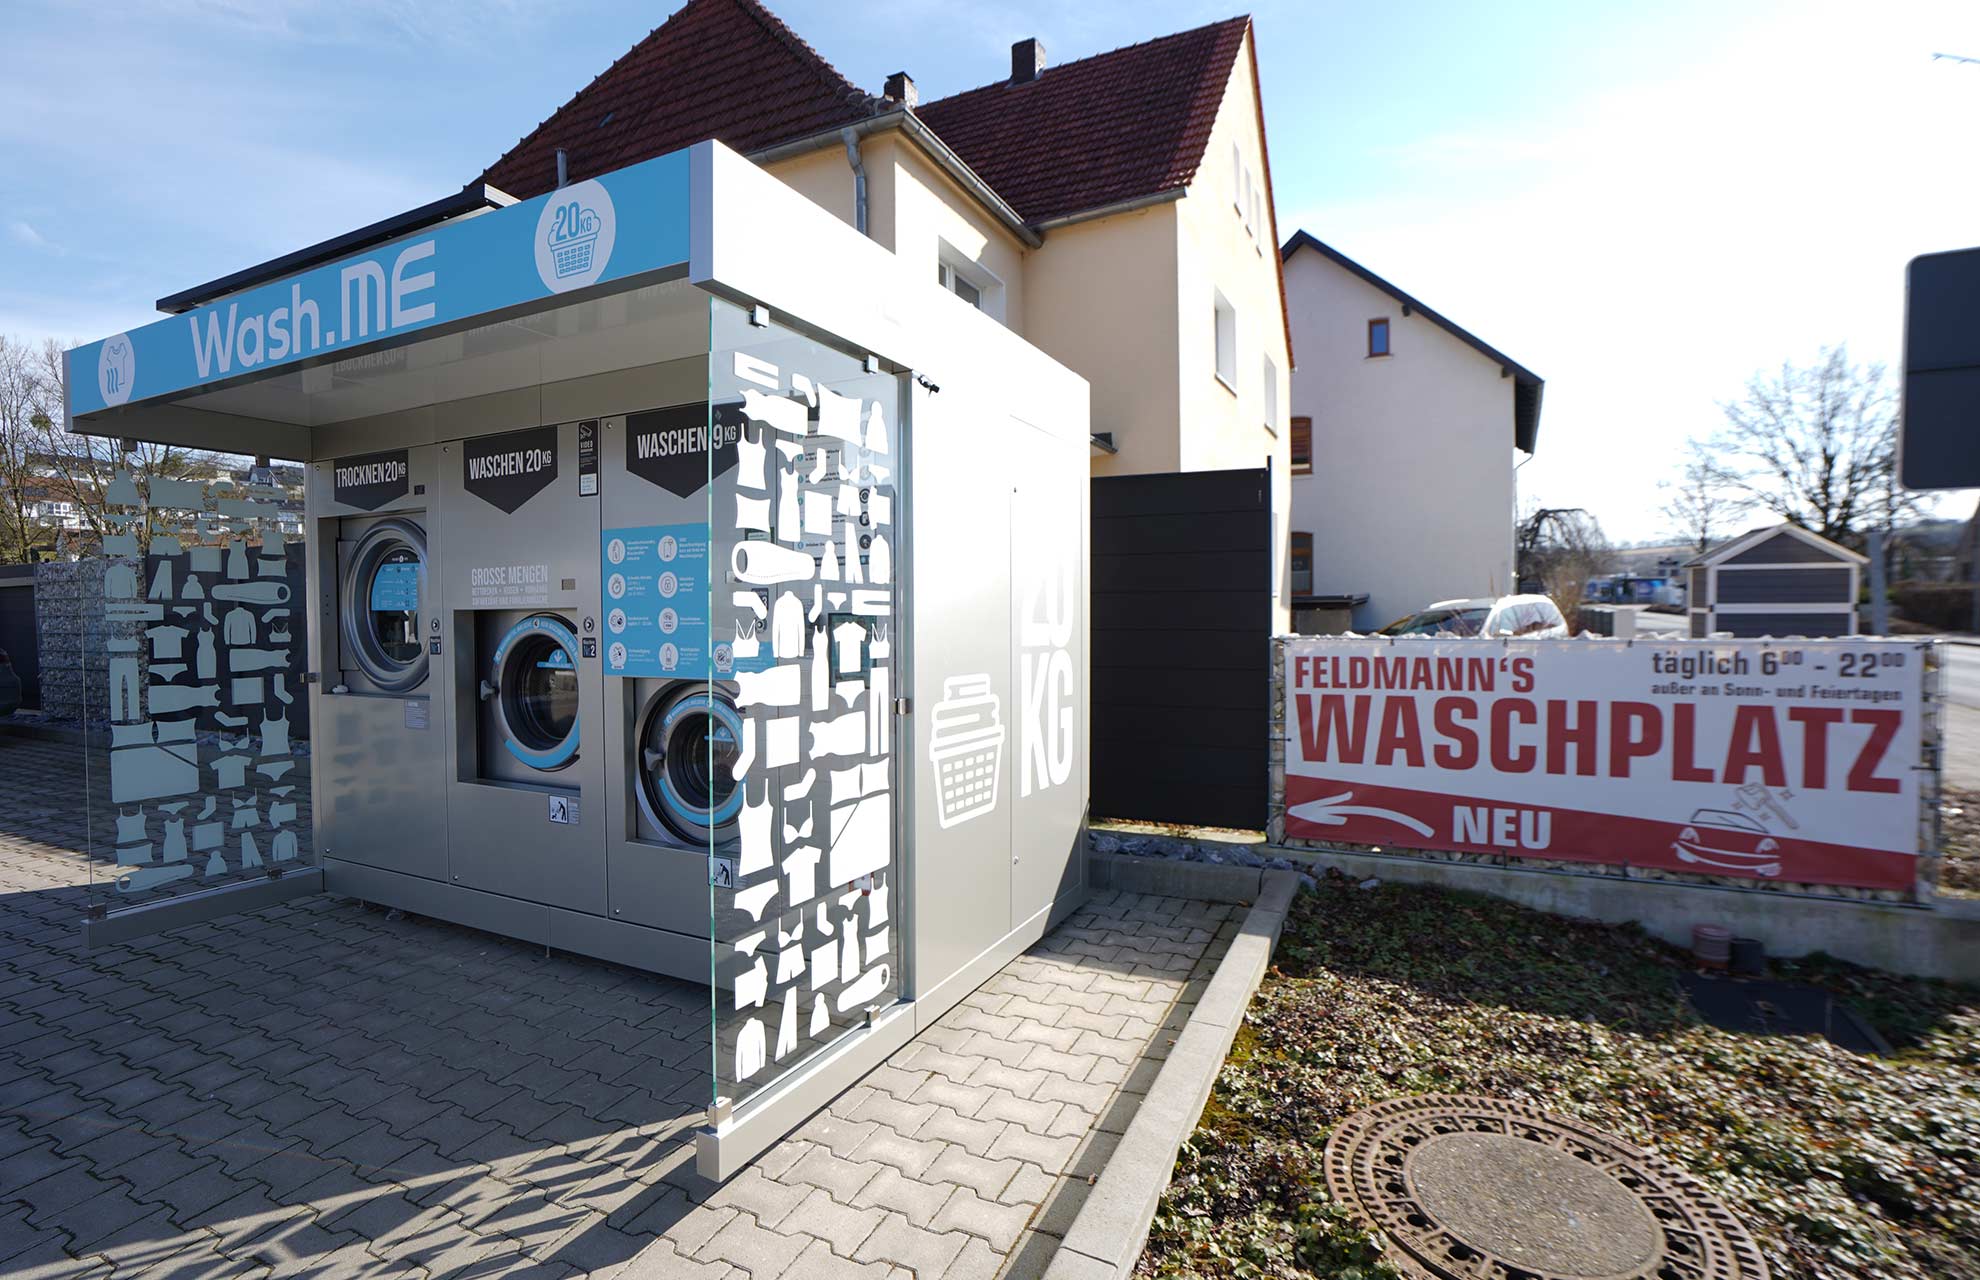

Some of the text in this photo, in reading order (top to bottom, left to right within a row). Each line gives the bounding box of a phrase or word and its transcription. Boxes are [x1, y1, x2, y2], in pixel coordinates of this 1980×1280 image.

[189, 239, 436, 378] Wash.ME
[637, 426, 707, 459] WASCHEN
[336, 462, 384, 488] TROCKNEN
[469, 451, 524, 480] WASCHEN
[471, 564, 548, 586] GROSSE MENGEN
[1652, 650, 1748, 680] täglich
[1651, 682, 1902, 703] außer an Sonn- und Feiertagen
[1020, 648, 1073, 797] KG
[1295, 693, 1903, 794] WASCHPLATZ
[1452, 805, 1552, 850] NEU
